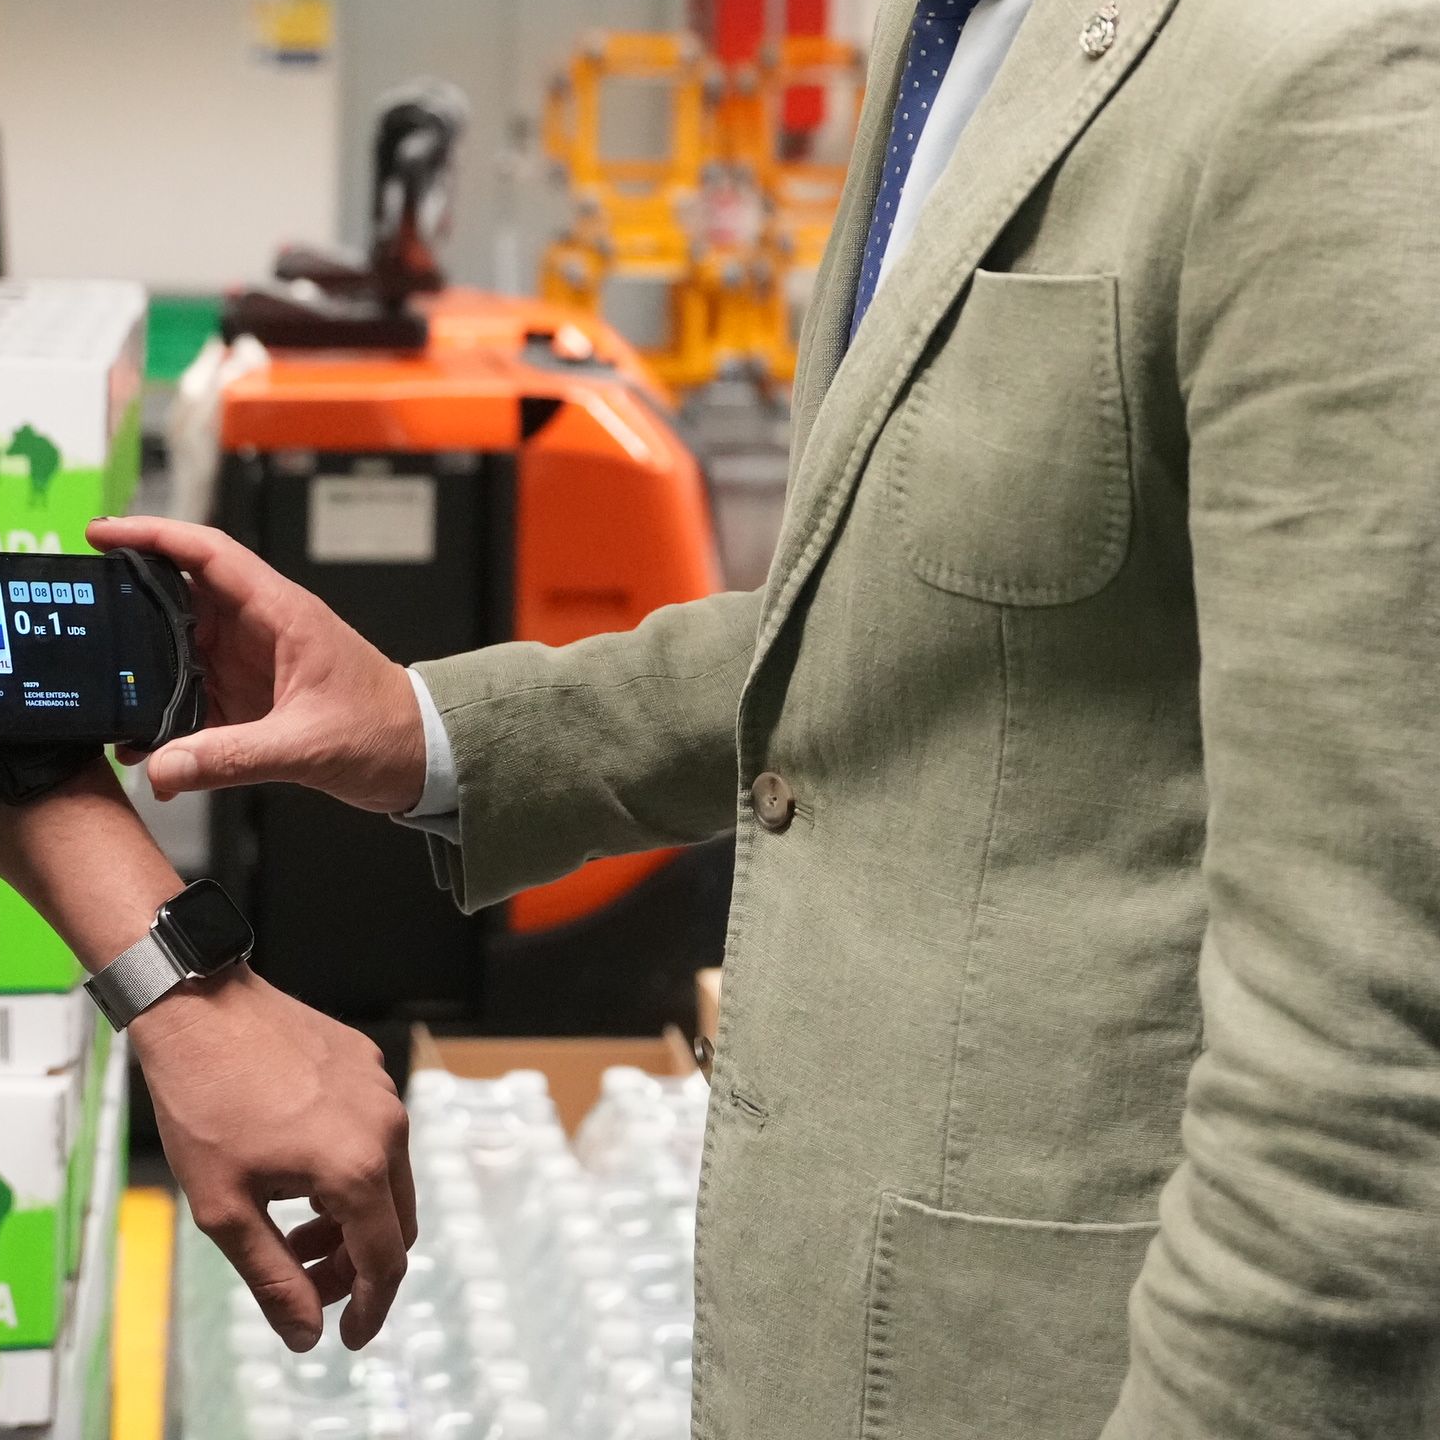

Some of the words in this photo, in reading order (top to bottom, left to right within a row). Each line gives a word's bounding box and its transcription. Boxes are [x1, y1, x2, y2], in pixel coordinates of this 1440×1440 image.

[13, 587, 25, 597] 01
[34, 587, 48, 598] 08
[56, 588, 68, 598] 01
[77, 588, 90, 598] 01
[14, 610, 31, 636] 0
[34, 626, 47, 635] DE
[48, 611, 62, 636] 1
[67, 626, 87, 636] UDS
[24, 691, 45, 699] LECHE
[45, 691, 70, 699] ENTERA
